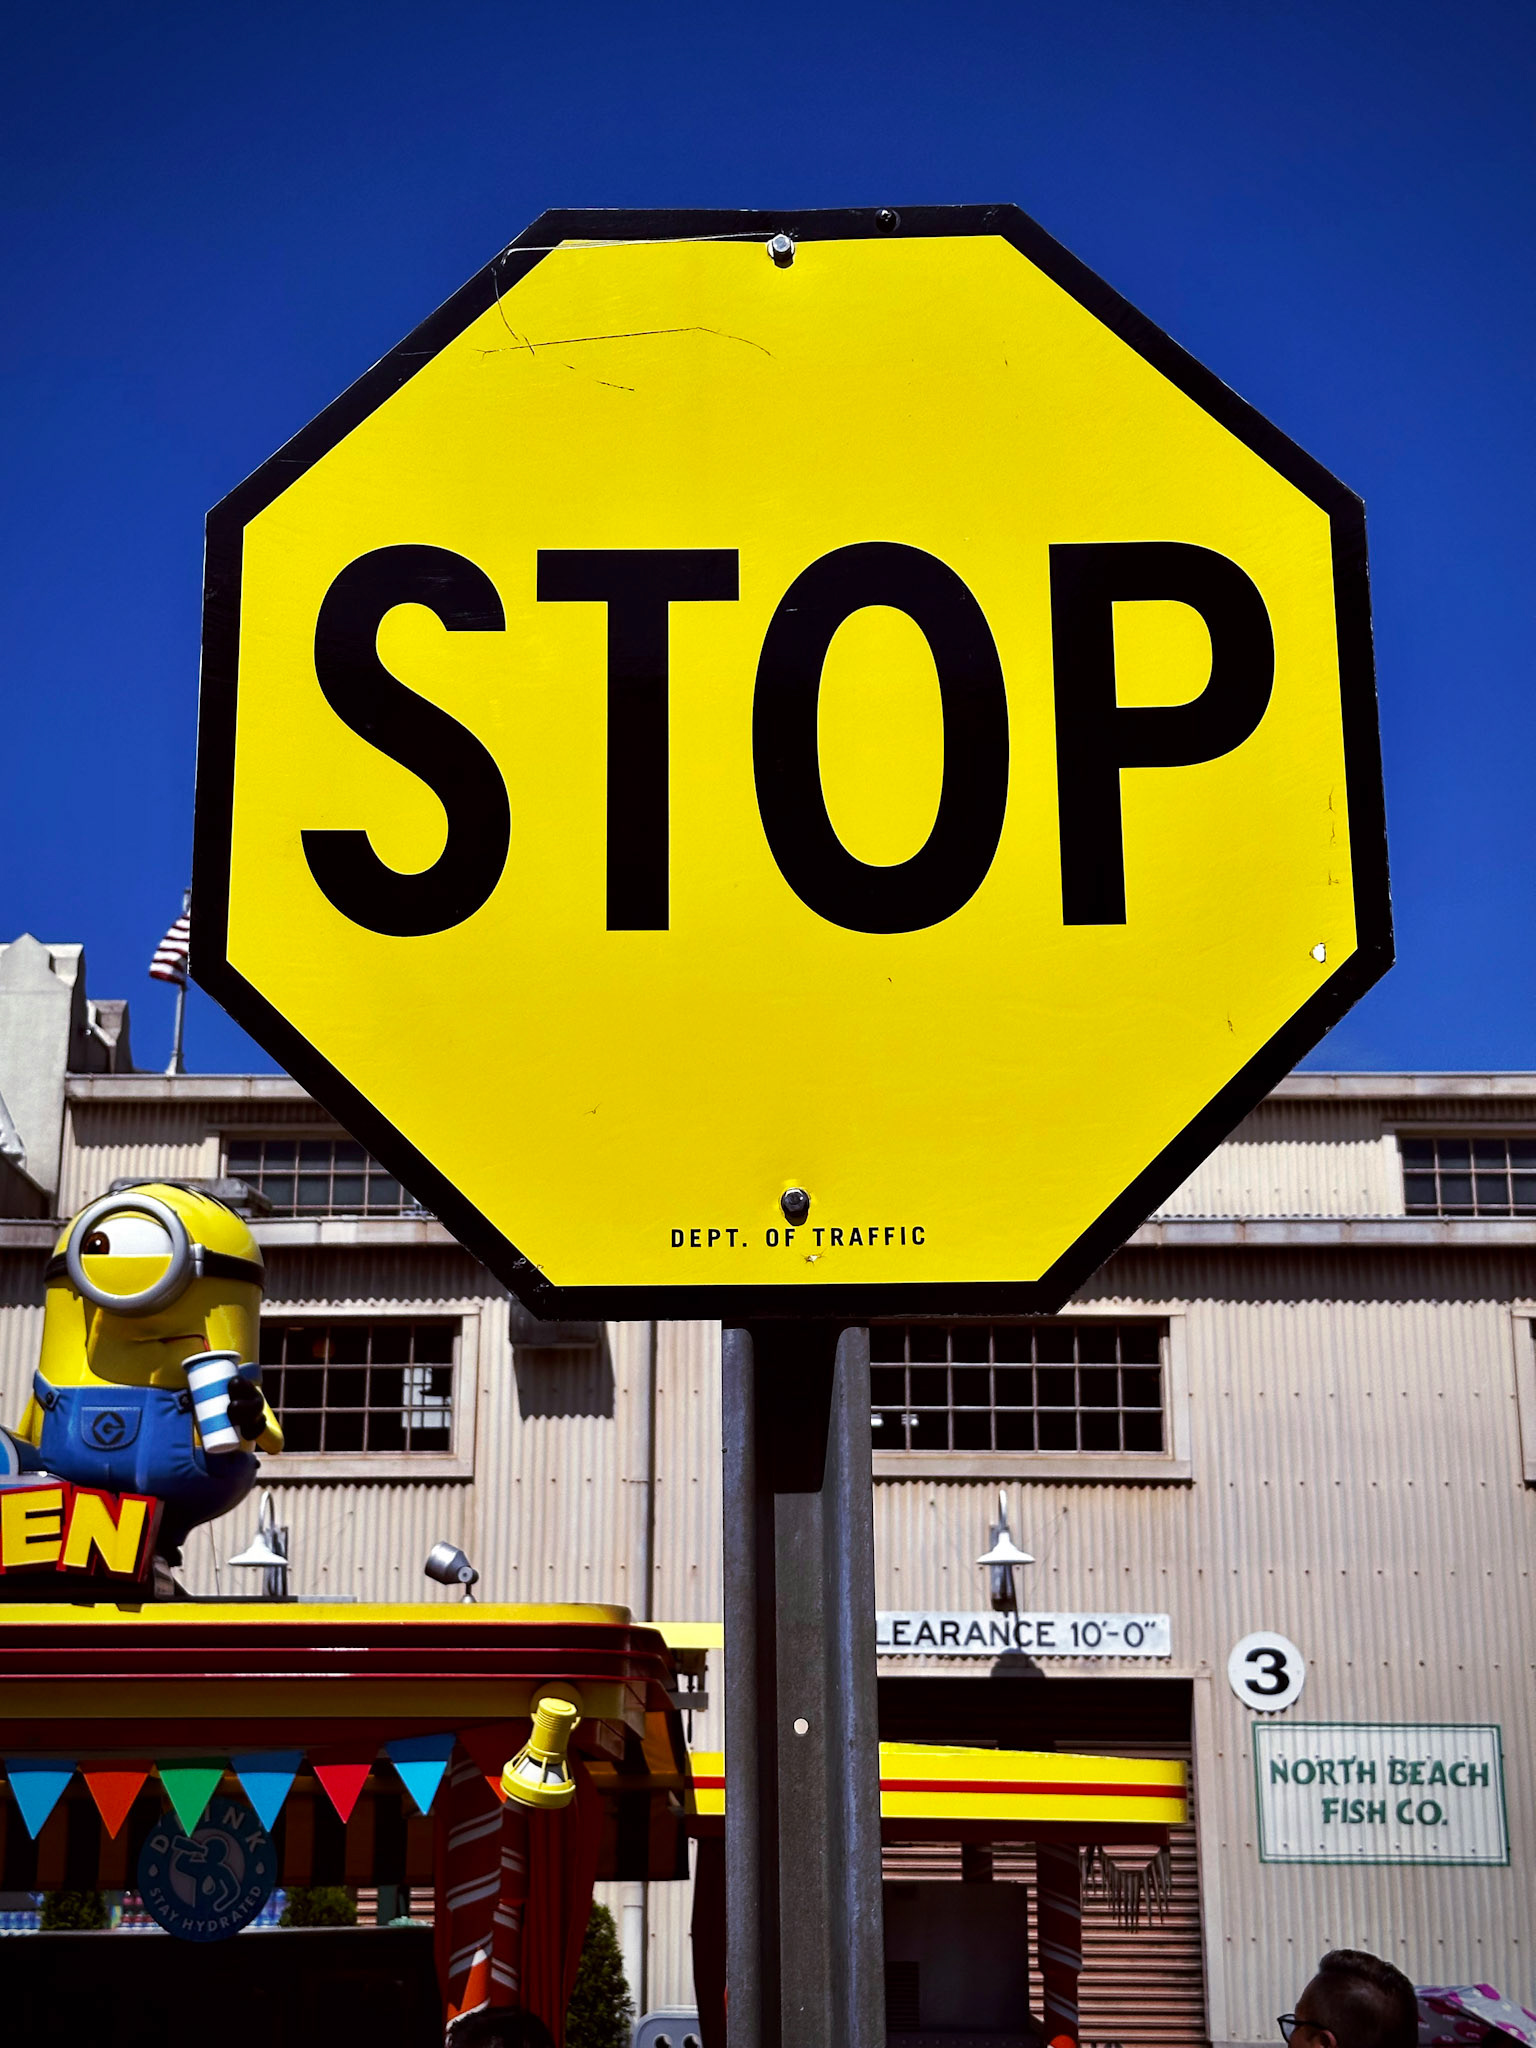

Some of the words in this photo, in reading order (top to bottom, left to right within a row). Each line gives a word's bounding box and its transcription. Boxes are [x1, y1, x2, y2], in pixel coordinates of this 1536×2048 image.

[300, 541, 1275, 938] STOP
[670, 1228, 748, 1248] DEPT.
[765, 1228, 796, 1247] OF
[812, 1226, 926, 1247] TRAFFIC
[0, 1486, 152, 1577] EN
[1244, 1646, 1290, 1696] 3
[1269, 1756, 1377, 1786] NORTH
[1387, 1758, 1490, 1788] BEACH
[150, 1804, 267, 1854] DINK
[1321, 1797, 1387, 1825] FISH
[1395, 1798, 1449, 1826] CO.
[150, 1886, 180, 1923] STAY
[181, 1885, 263, 1932] HYDRATED
